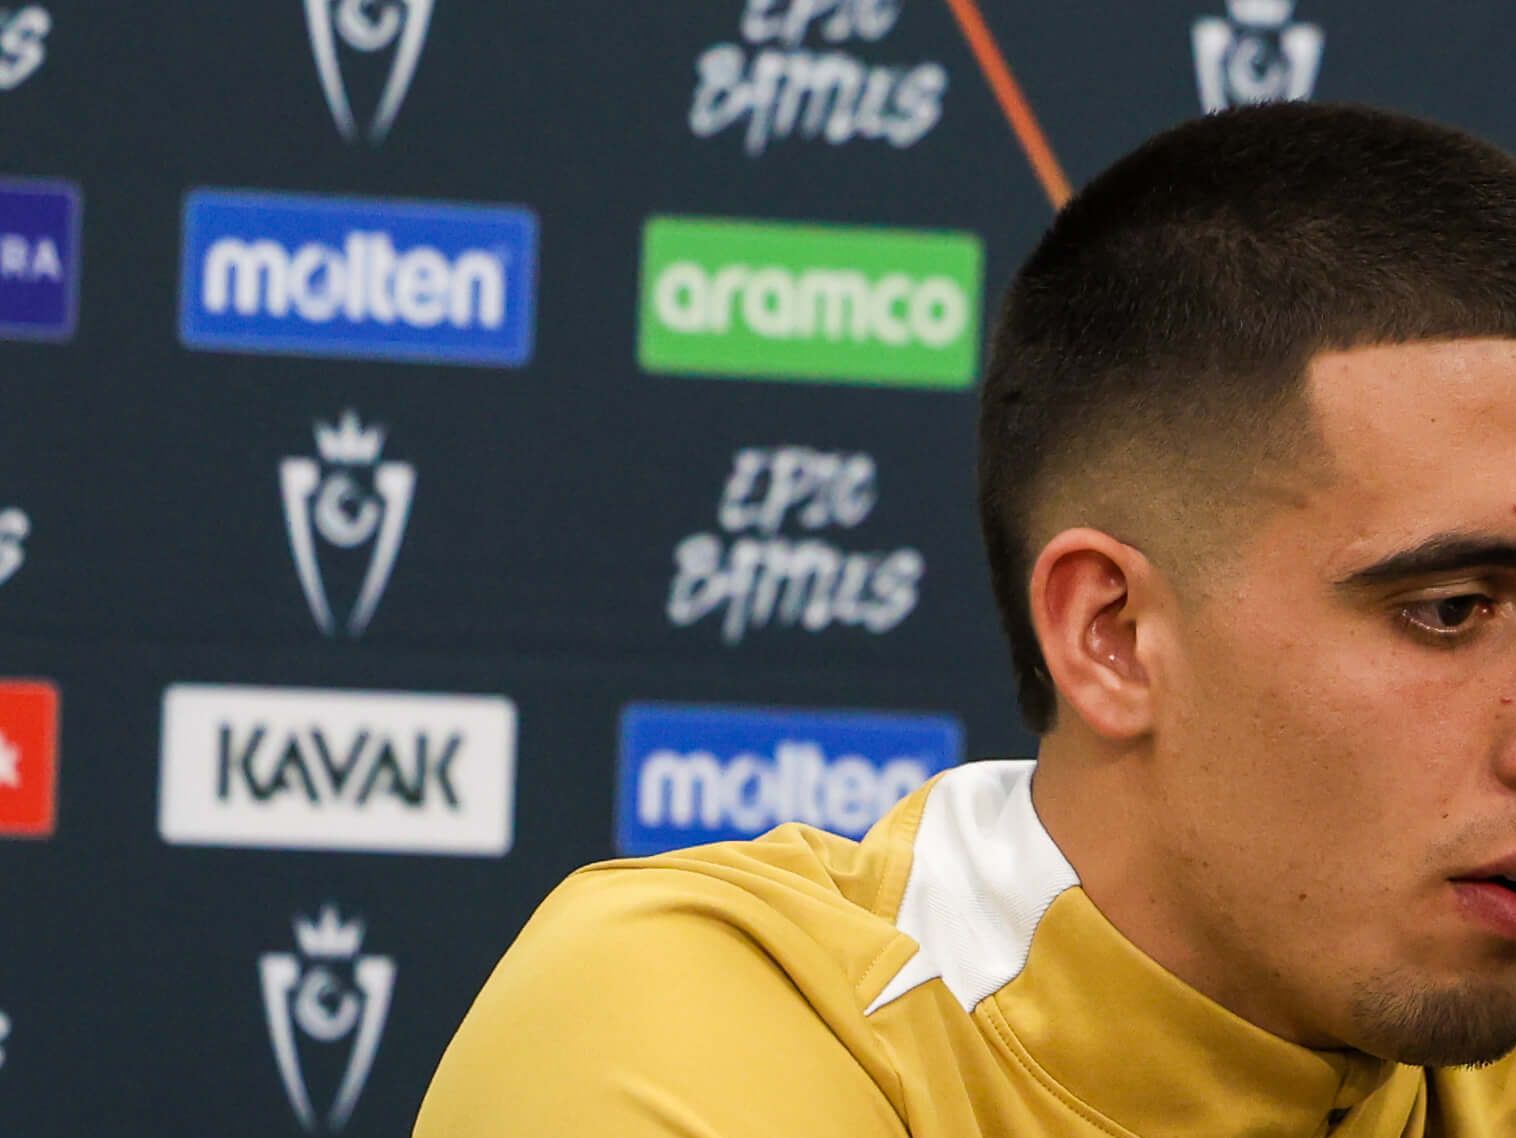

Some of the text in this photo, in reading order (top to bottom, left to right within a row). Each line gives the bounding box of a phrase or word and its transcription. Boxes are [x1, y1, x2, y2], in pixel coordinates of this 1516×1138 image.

[204, 230, 506, 328] molten
[654, 263, 967, 347] aramco
[217, 724, 461, 808] KAVAK
